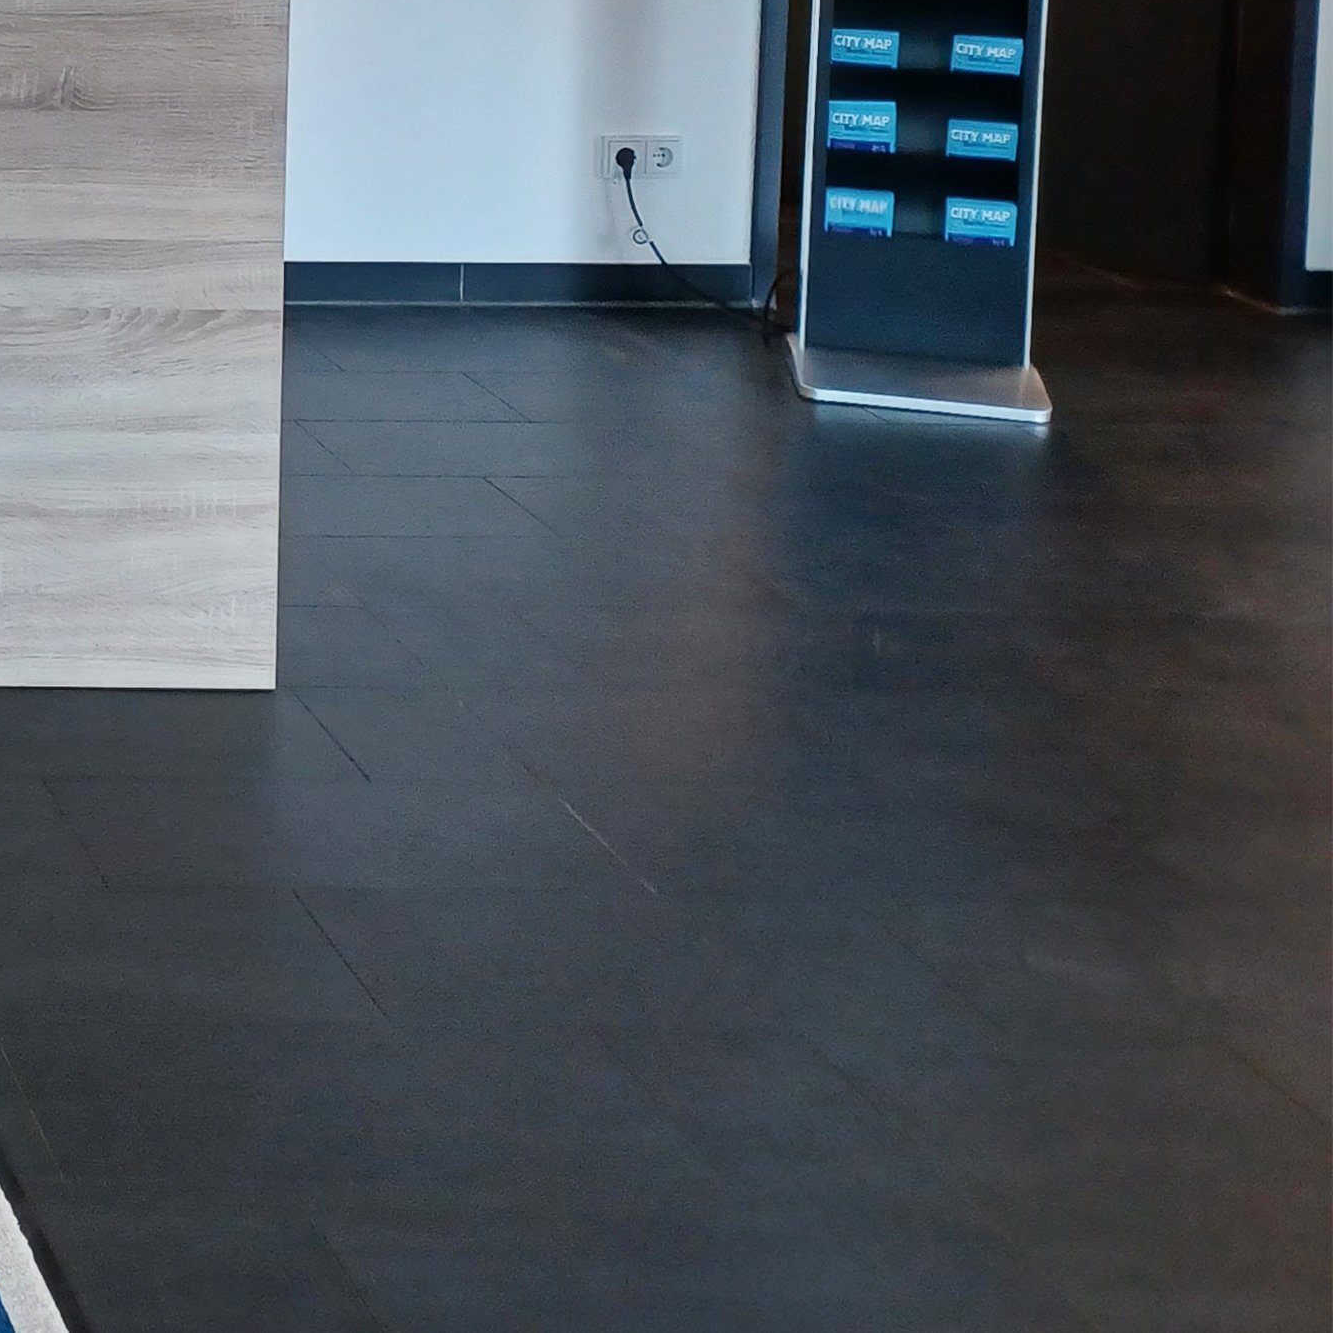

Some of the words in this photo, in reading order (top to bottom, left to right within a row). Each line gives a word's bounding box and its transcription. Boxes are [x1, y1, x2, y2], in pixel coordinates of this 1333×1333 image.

[834, 35, 861, 48] CITY
[864, 37, 893, 51] MAP
[955, 43, 984, 56] CITY
[985, 46, 1017, 59] MAP
[832, 112, 860, 126] CITY
[862, 115, 891, 127] MAP
[950, 129, 979, 142] CITY
[982, 131, 1012, 144] MAP
[950, 207, 979, 220] CITY
[982, 210, 1011, 223] MAP
